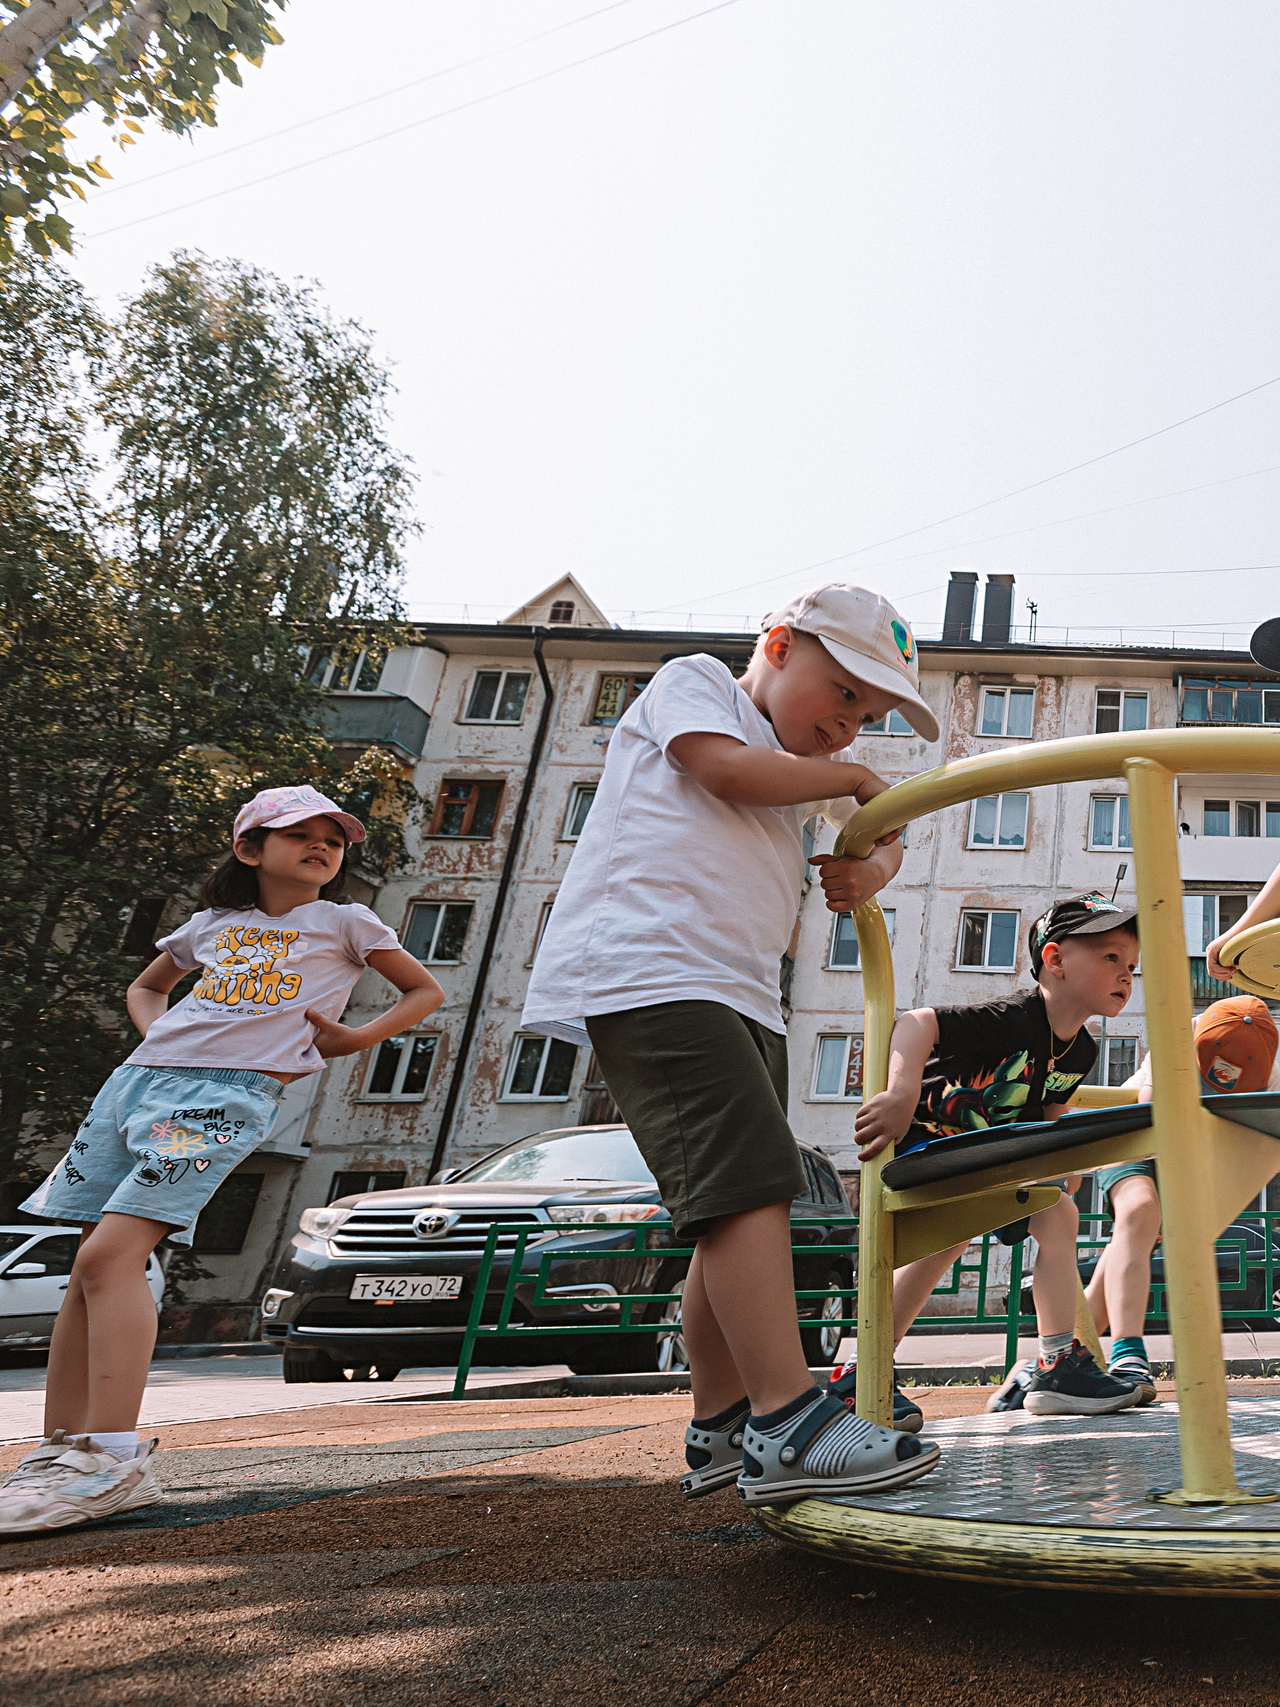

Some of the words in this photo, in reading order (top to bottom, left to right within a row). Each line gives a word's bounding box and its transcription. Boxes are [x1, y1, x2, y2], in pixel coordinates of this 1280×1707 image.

[604, 678, 623, 690] 60
[601, 690, 618, 703] 41
[598, 704, 617, 716] 44
[170, 1108, 226, 1120] DREAM
[203, 1120, 232, 1132] BIG
[439, 1277, 457, 1291] 72
